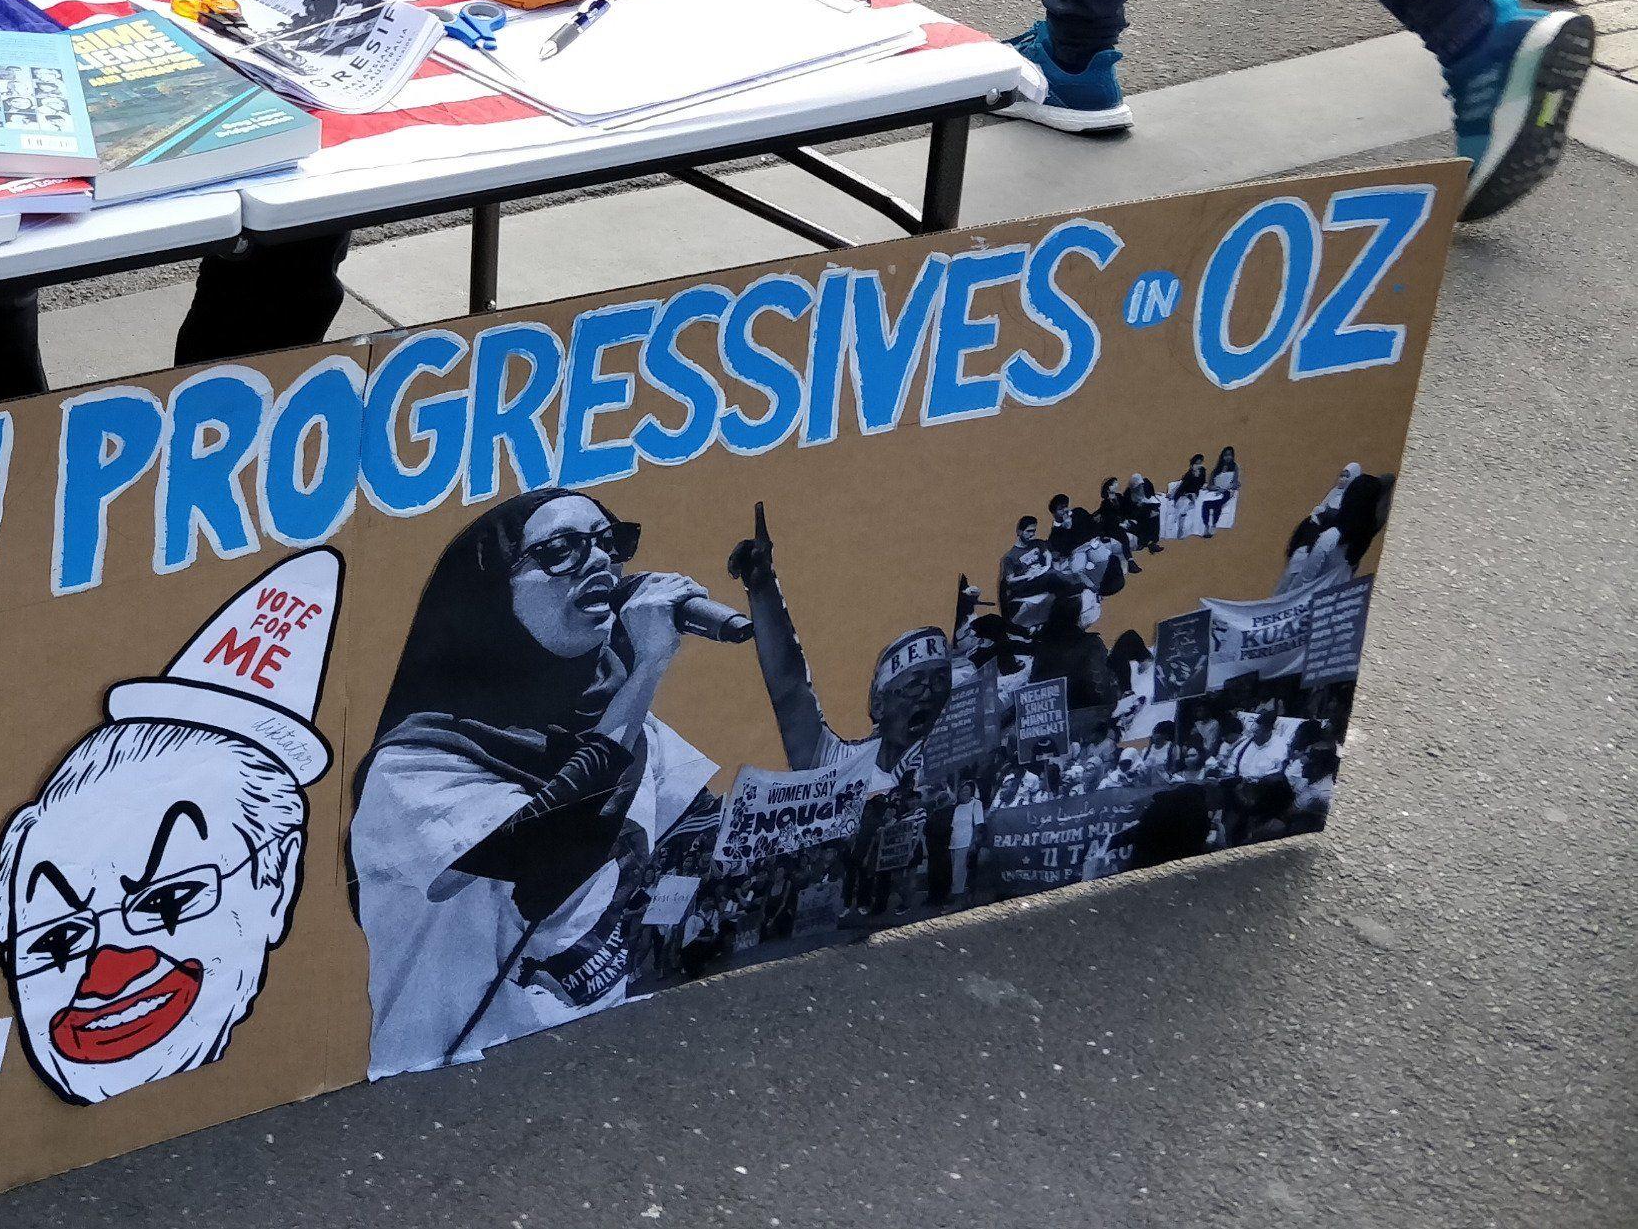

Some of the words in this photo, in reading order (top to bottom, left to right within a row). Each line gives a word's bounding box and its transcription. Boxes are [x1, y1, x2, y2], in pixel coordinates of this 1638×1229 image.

[50, 217, 1125, 597] PROGRESSIVES
[1124, 271, 1182, 326] IN
[1193, 183, 1437, 390] OZ
[250, 614, 292, 641] FOR
[255, 587, 323, 630] VOTE
[203, 627, 292, 689] ME
[251, 717, 314, 771] diktator
[767, 782, 812, 805] WOMEN
[812, 779, 837, 799] SAY
